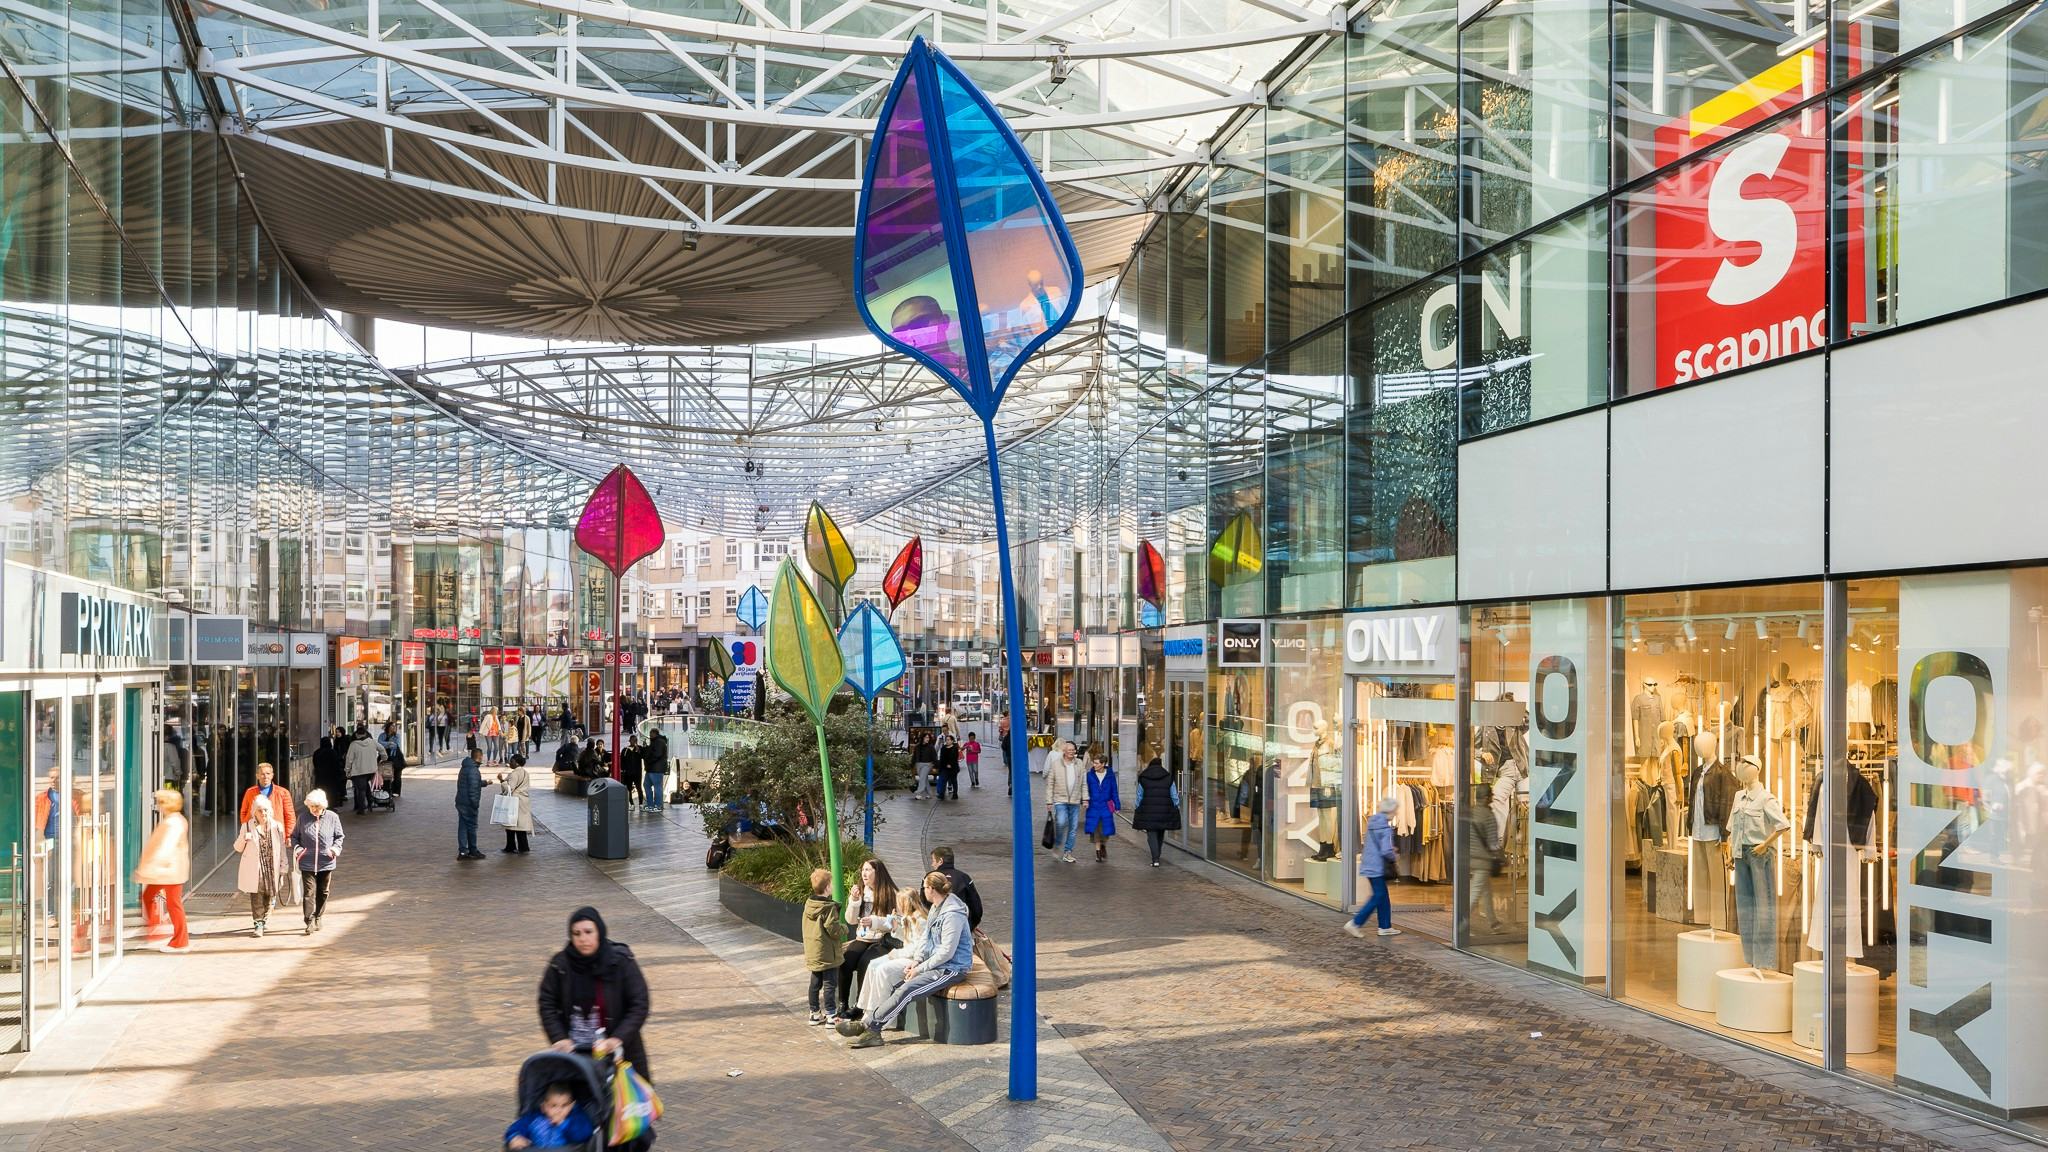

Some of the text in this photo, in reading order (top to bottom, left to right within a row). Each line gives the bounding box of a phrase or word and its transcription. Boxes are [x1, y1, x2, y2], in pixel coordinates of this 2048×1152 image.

[1706, 133, 1798, 306] S
[77, 593, 153, 657] PRIMARK
[1224, 637, 1260, 648] ONLY
[1347, 614, 1443, 663] ONLY
[1287, 701, 1323, 854] ONLY
[1534, 655, 1578, 971] ONLY
[1909, 650, 1995, 1100] ONLY
